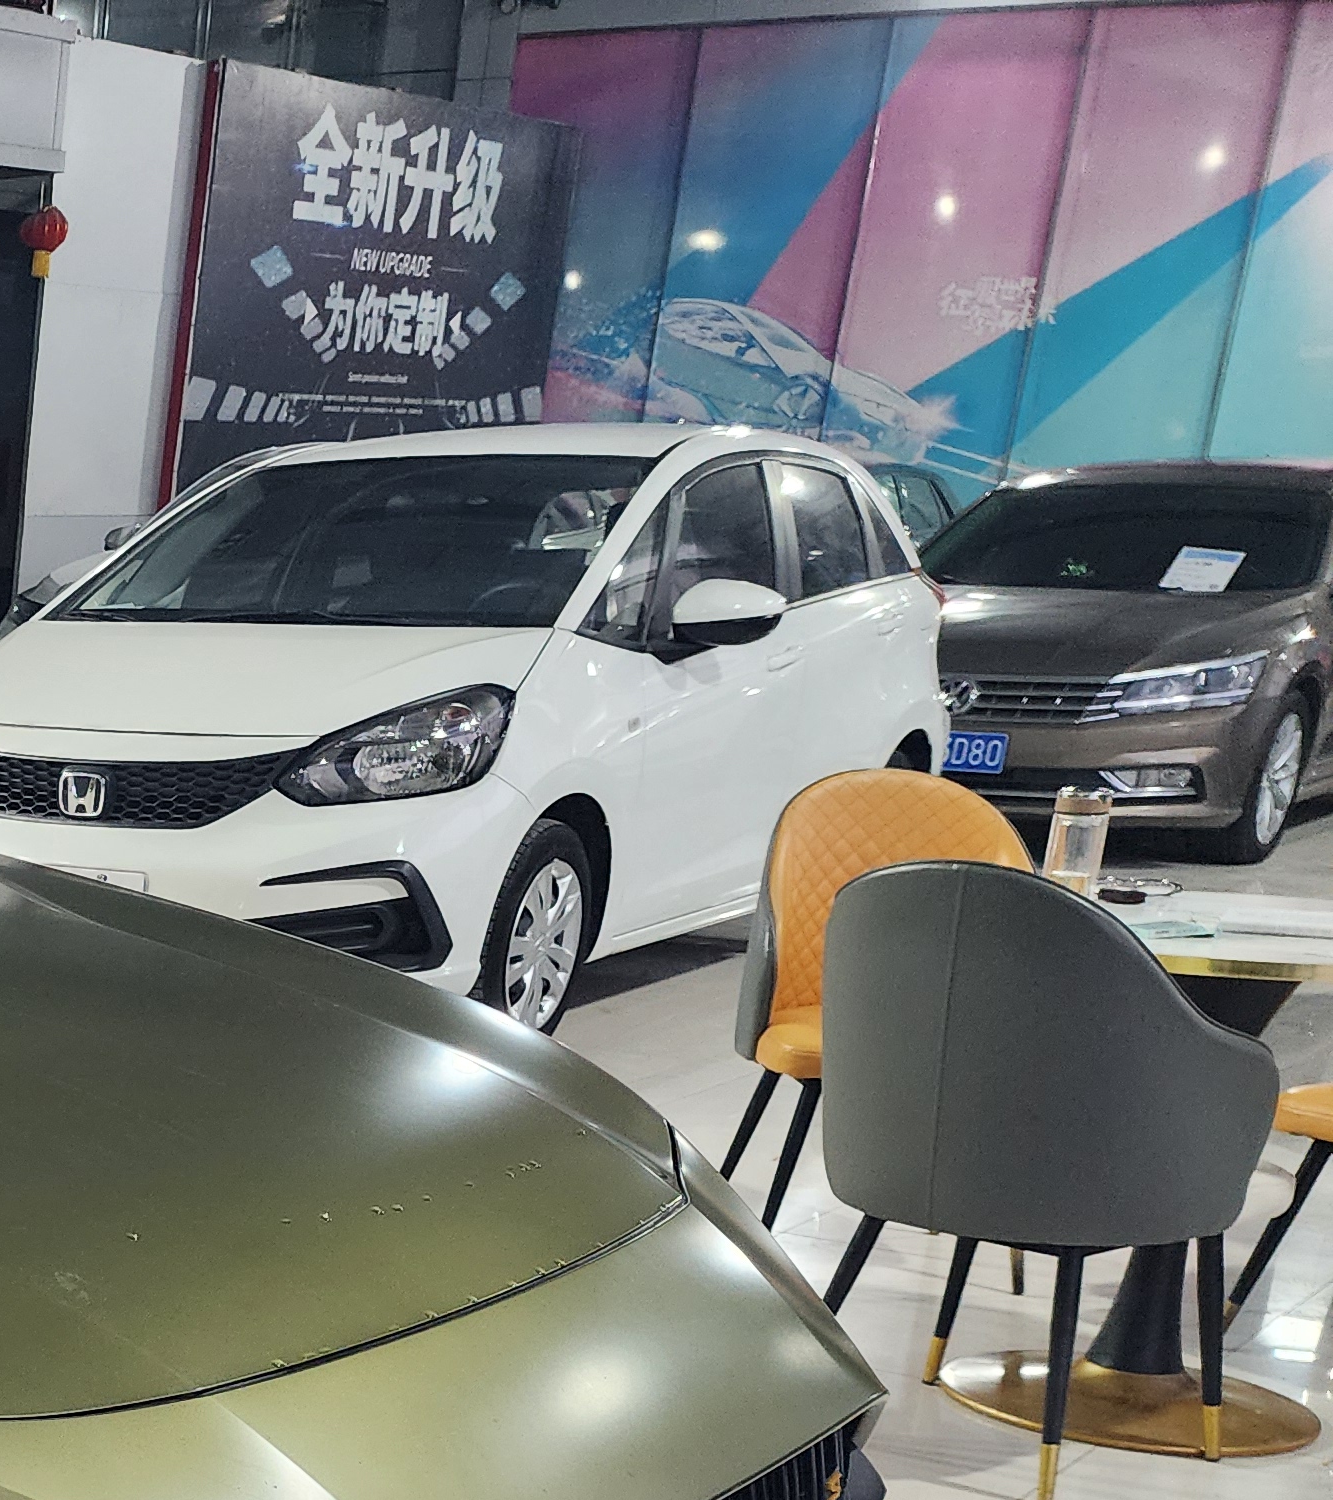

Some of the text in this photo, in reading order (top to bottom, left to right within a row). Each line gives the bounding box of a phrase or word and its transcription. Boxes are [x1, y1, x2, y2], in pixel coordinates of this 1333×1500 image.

[292, 102, 504, 244] 全新升级
[349, 247, 434, 278] NEW UPGRADE
[321, 280, 450, 356] 为你定制
